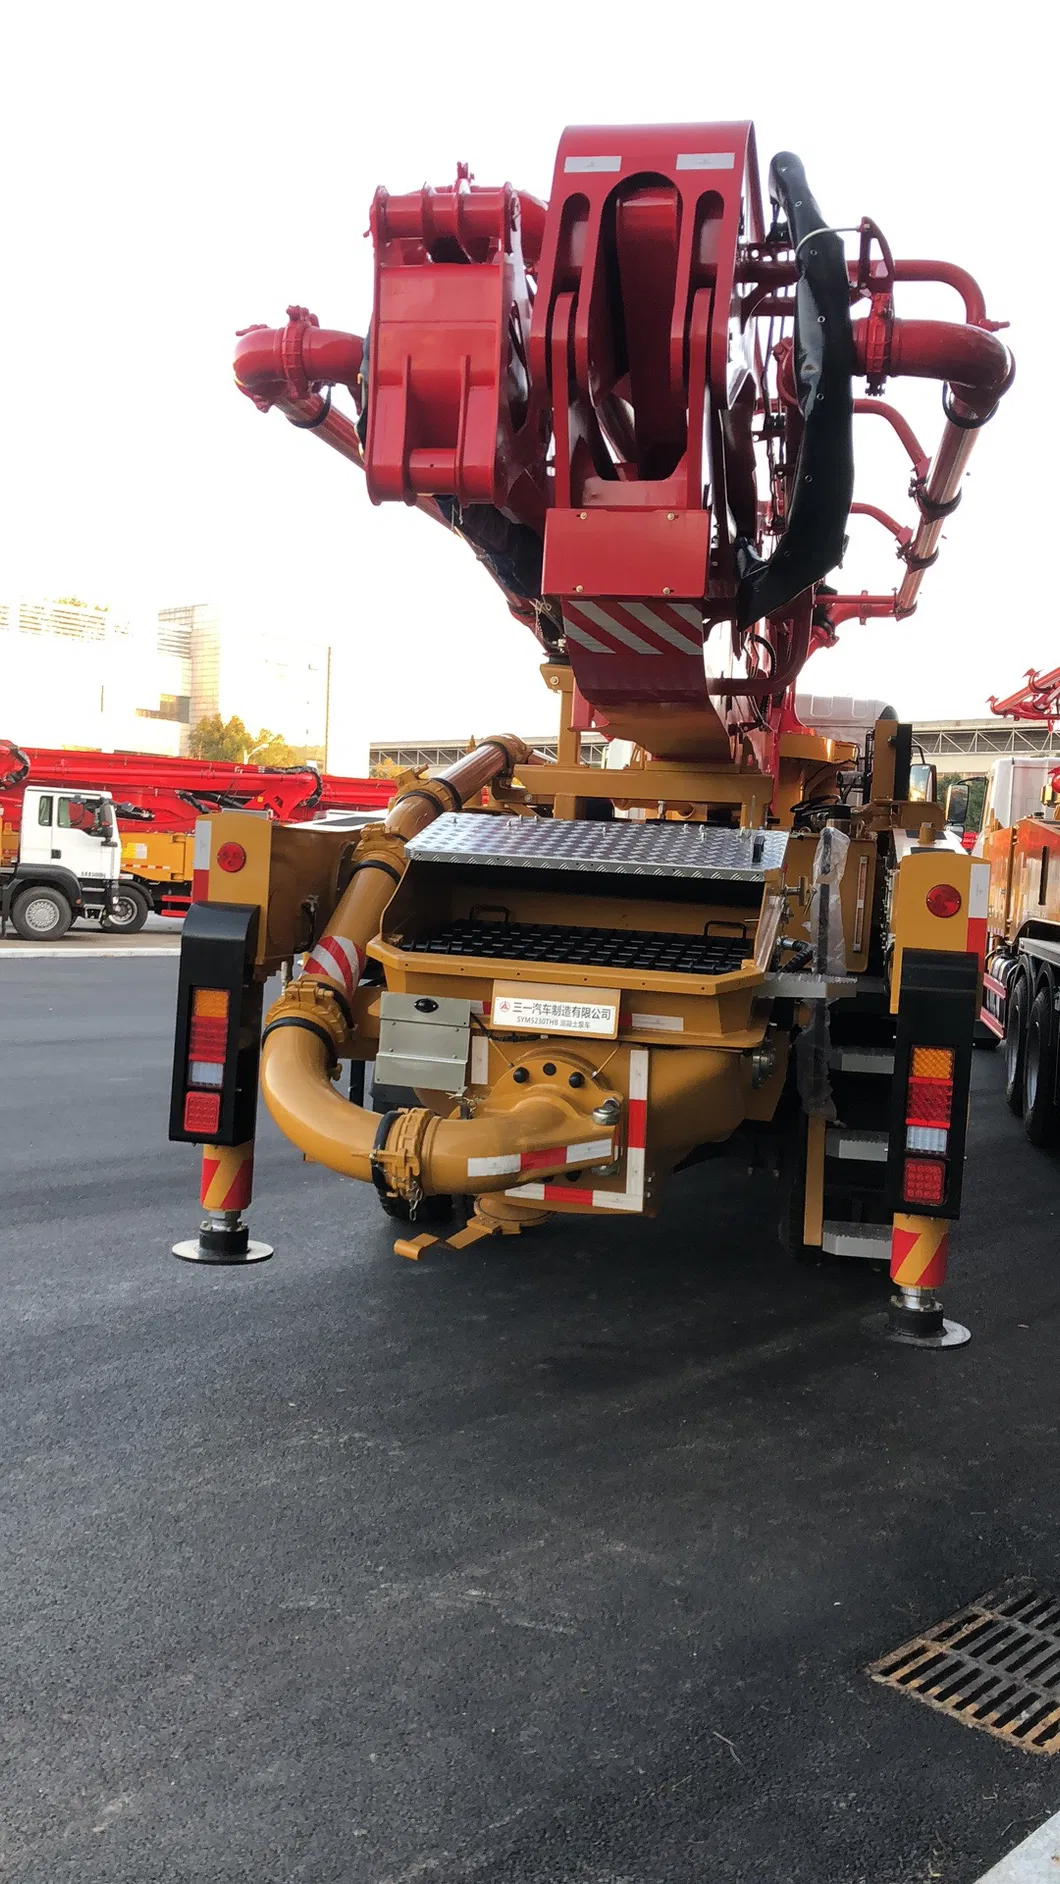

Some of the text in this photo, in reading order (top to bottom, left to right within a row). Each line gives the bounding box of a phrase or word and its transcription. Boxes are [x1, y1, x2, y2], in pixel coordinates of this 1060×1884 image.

[512, 1001, 611, 1020] 三一汽车制造有限公司
